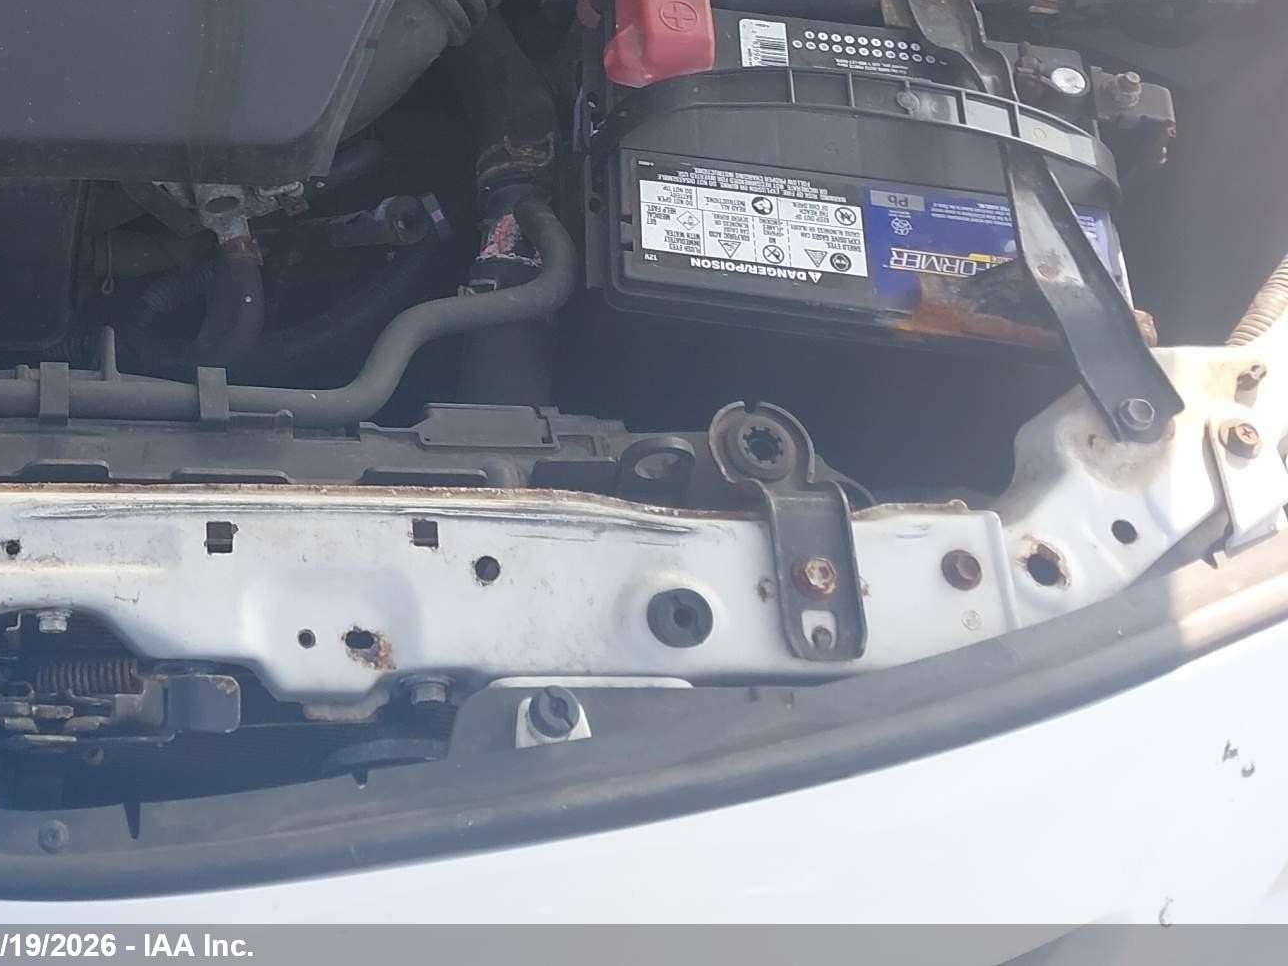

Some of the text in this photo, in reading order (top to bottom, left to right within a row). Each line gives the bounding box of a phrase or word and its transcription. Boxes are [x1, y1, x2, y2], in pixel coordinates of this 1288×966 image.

[888, 195, 908, 207] Pb
[647, 211, 670, 220] MEDICAL
[644, 253, 658, 261] 12V
[690, 257, 807, 281] DANGER/POISON
